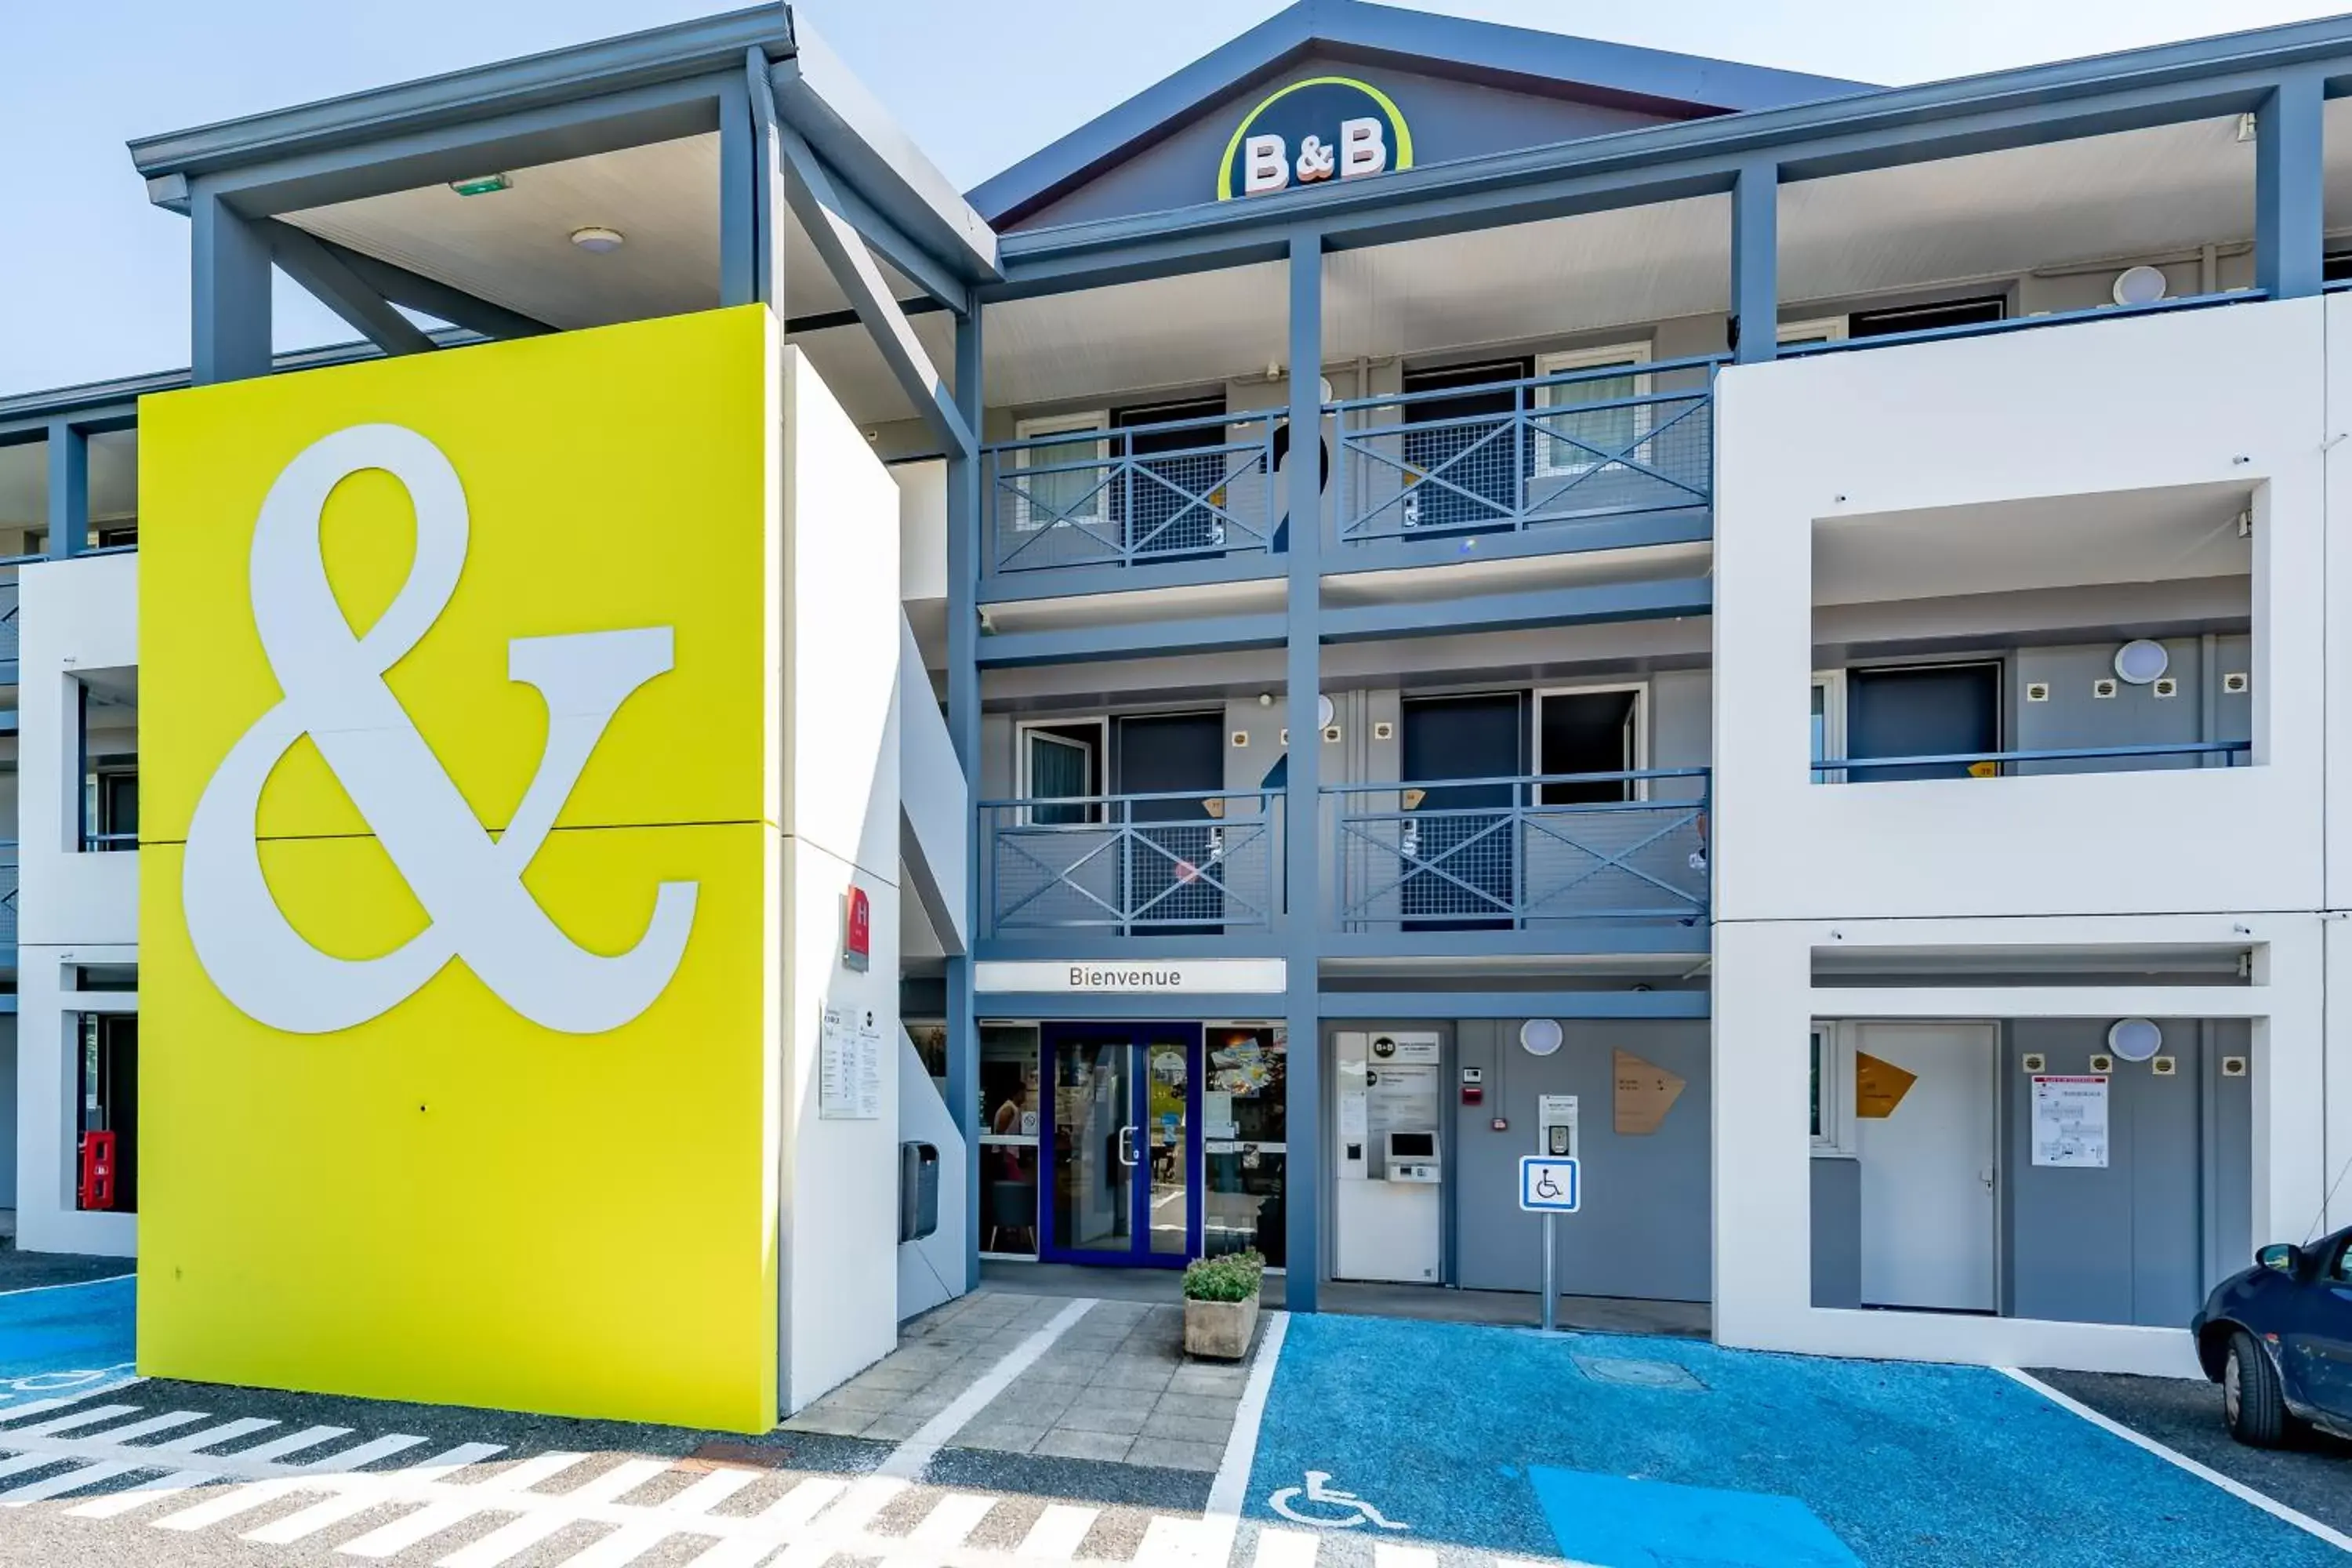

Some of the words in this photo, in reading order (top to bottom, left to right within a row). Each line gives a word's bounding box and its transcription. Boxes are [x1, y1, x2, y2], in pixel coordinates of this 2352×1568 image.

[1245, 117, 1387, 197] B&B
[183, 423, 699, 1035] &
[1069, 967, 1181, 985] Bienvenue
